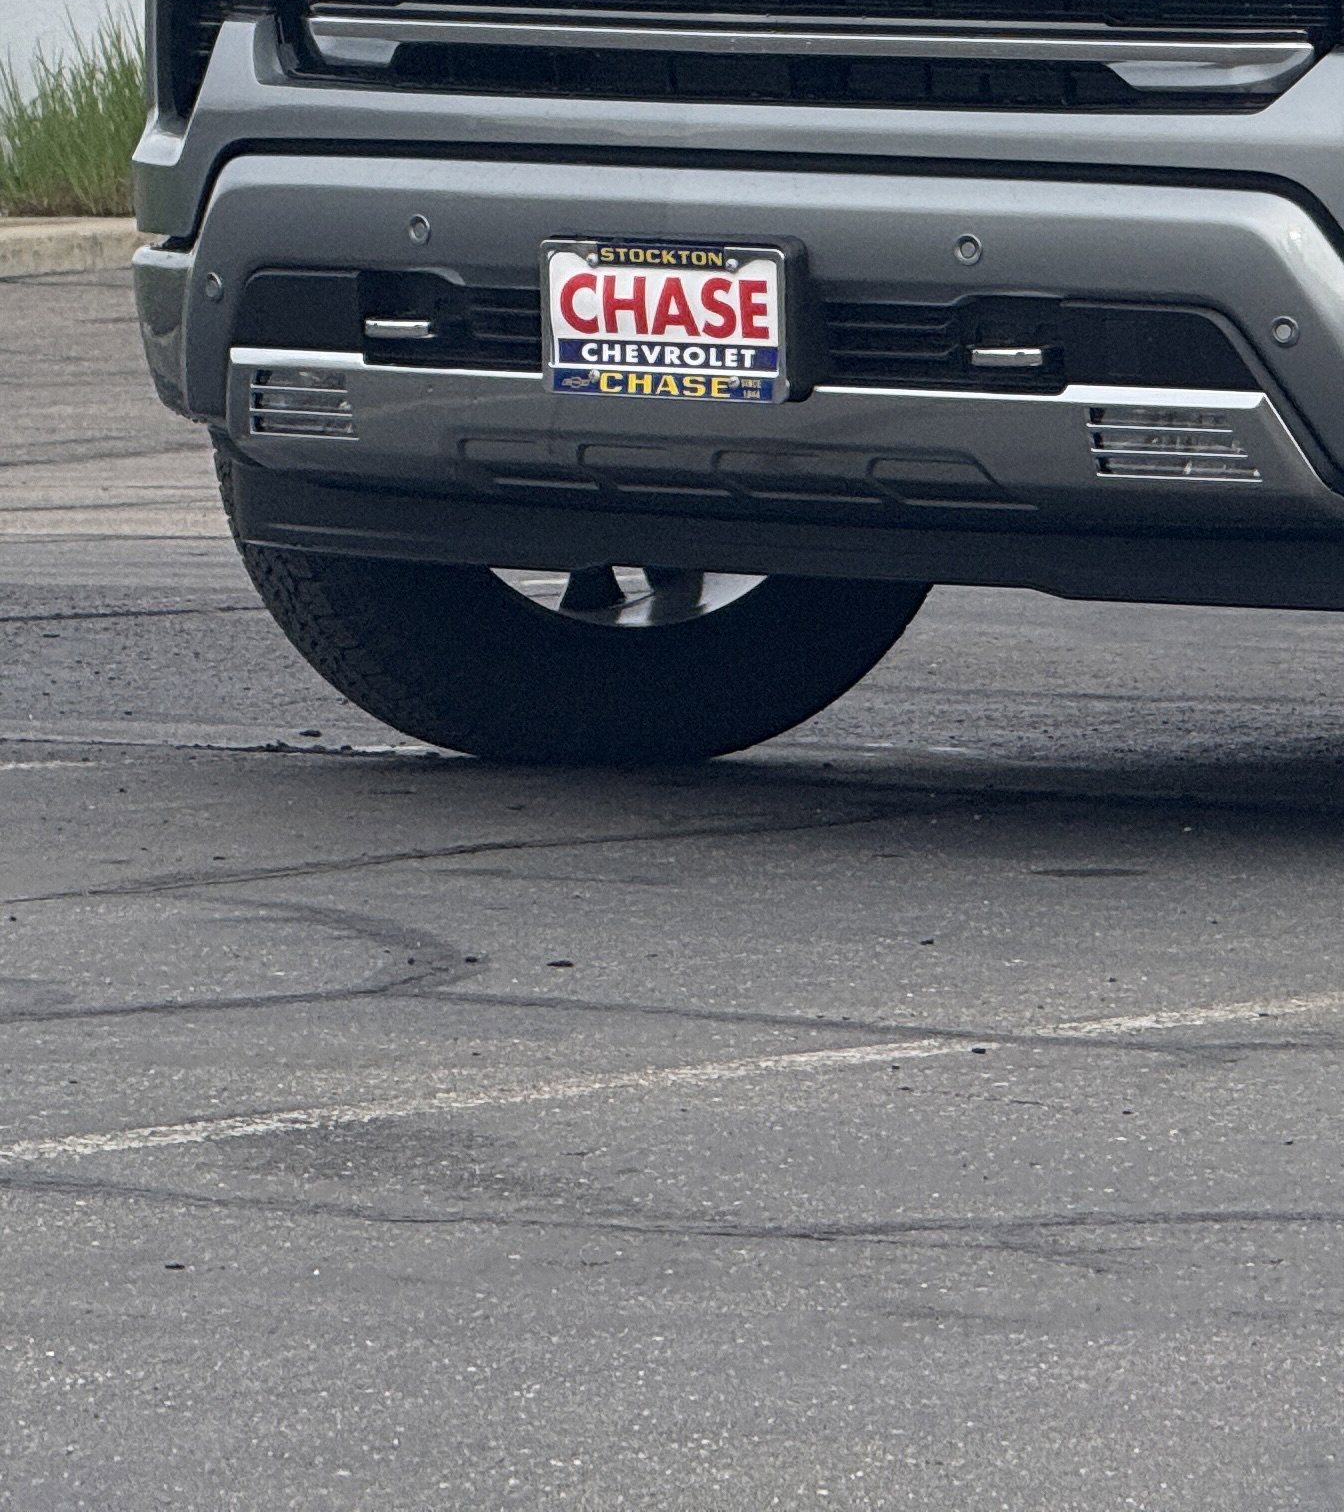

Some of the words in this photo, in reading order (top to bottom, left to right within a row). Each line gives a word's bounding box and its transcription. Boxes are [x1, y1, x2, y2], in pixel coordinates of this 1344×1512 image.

[600, 247, 723, 267] STOCKTON
[560, 273, 770, 339] CHASE
[581, 342, 756, 368] CHEVROLET
[600, 372, 731, 399] CHASE
